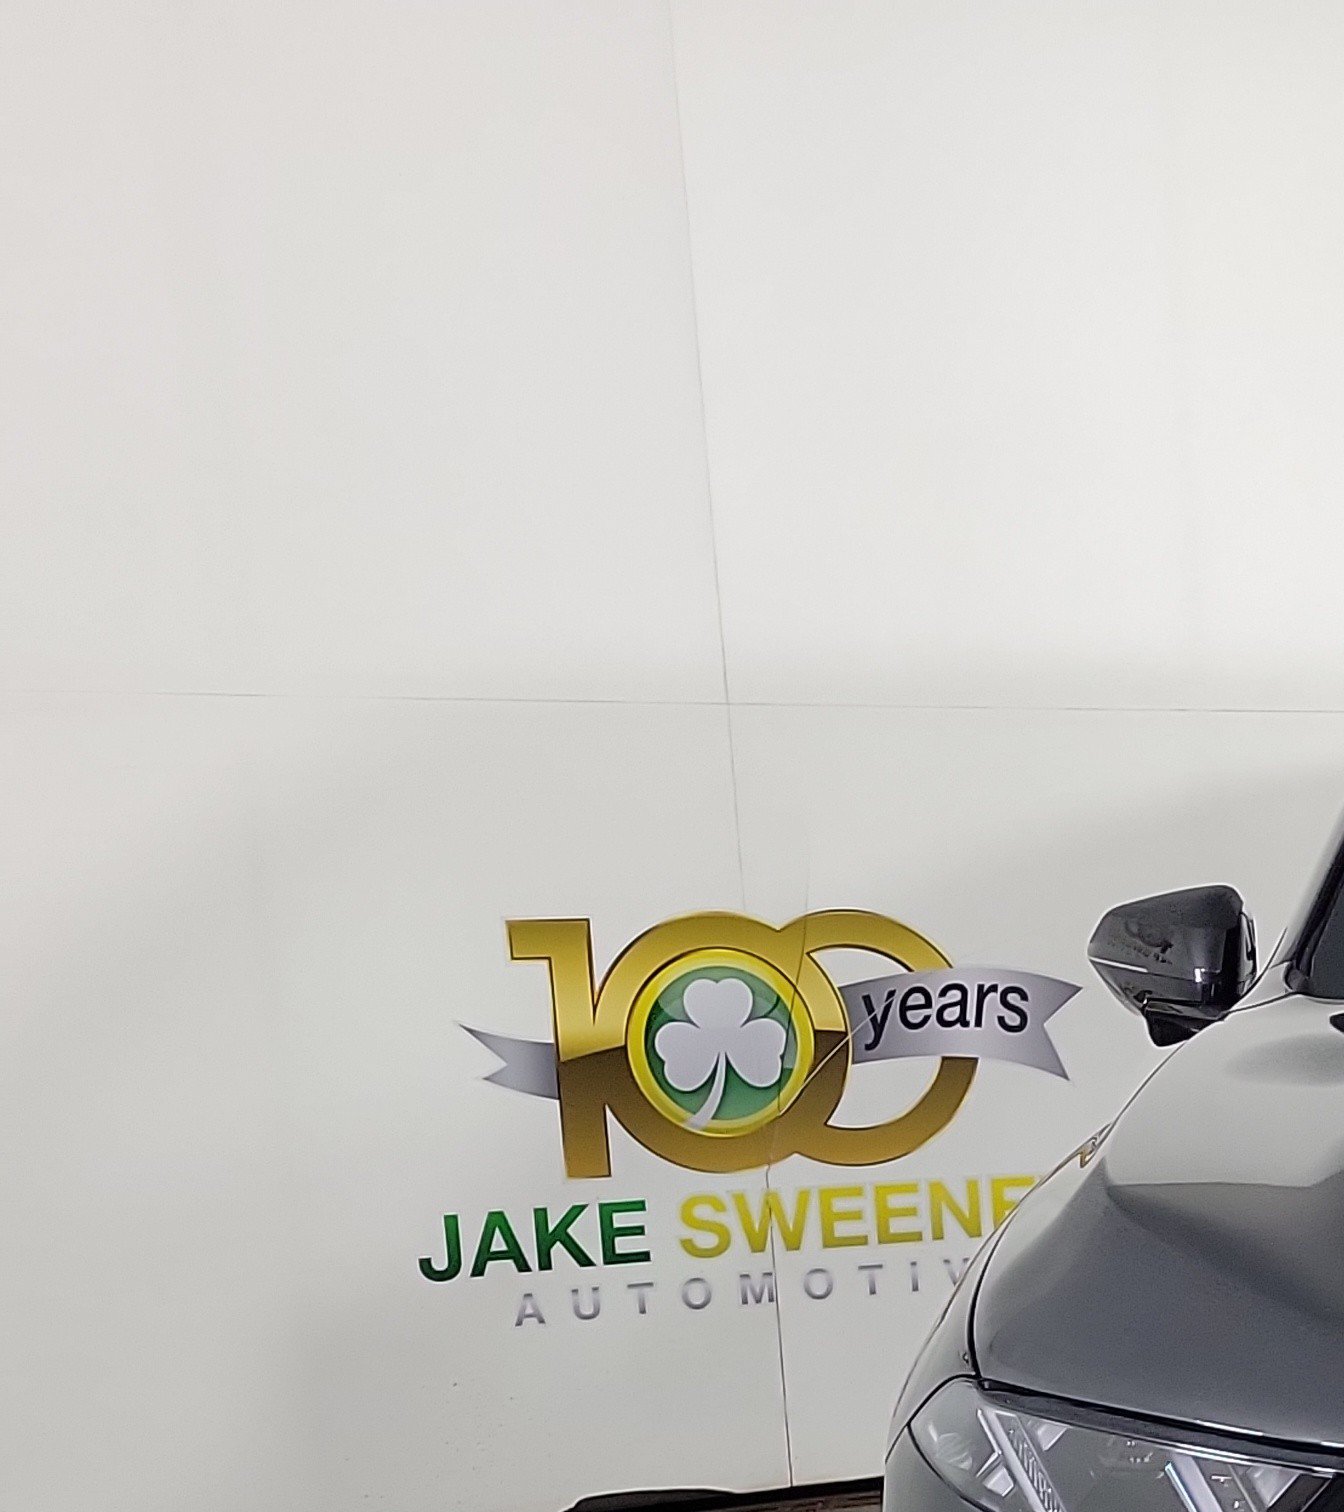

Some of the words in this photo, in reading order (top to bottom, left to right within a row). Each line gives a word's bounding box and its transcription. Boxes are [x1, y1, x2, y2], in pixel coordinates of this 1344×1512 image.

[505, 909, 978, 1179] 100
[863, 981, 1030, 1050] years
[418, 1199, 652, 1282] JAKE
[678, 1174, 1036, 1261] SWEENE
[514, 1256, 970, 1328] AUTOMOTIV
